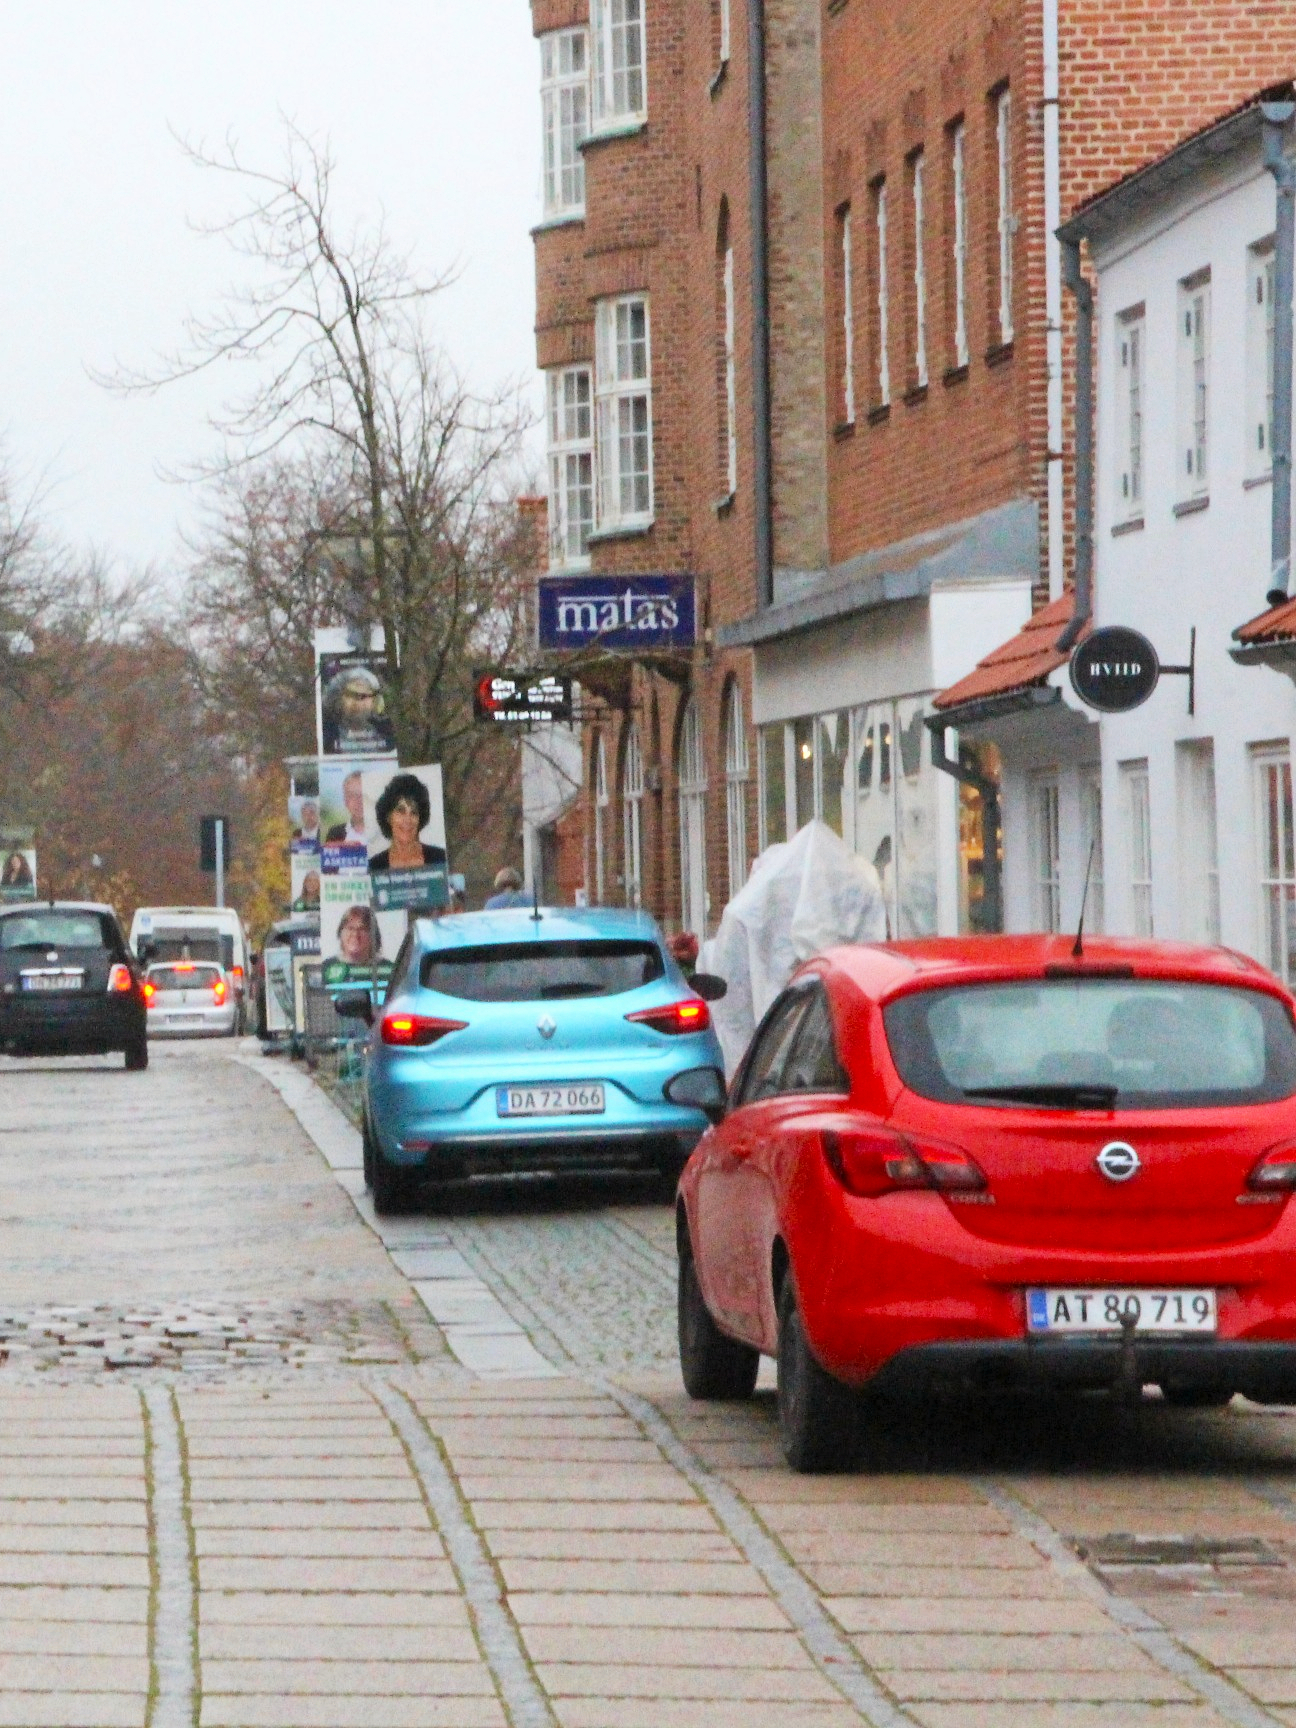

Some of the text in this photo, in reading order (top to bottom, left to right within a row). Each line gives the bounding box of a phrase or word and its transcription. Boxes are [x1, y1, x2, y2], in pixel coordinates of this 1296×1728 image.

[556, 588, 679, 632] matas
[511, 1088, 601, 1109] DA 72 066
[1054, 1295, 1210, 1324] AT 80 719
